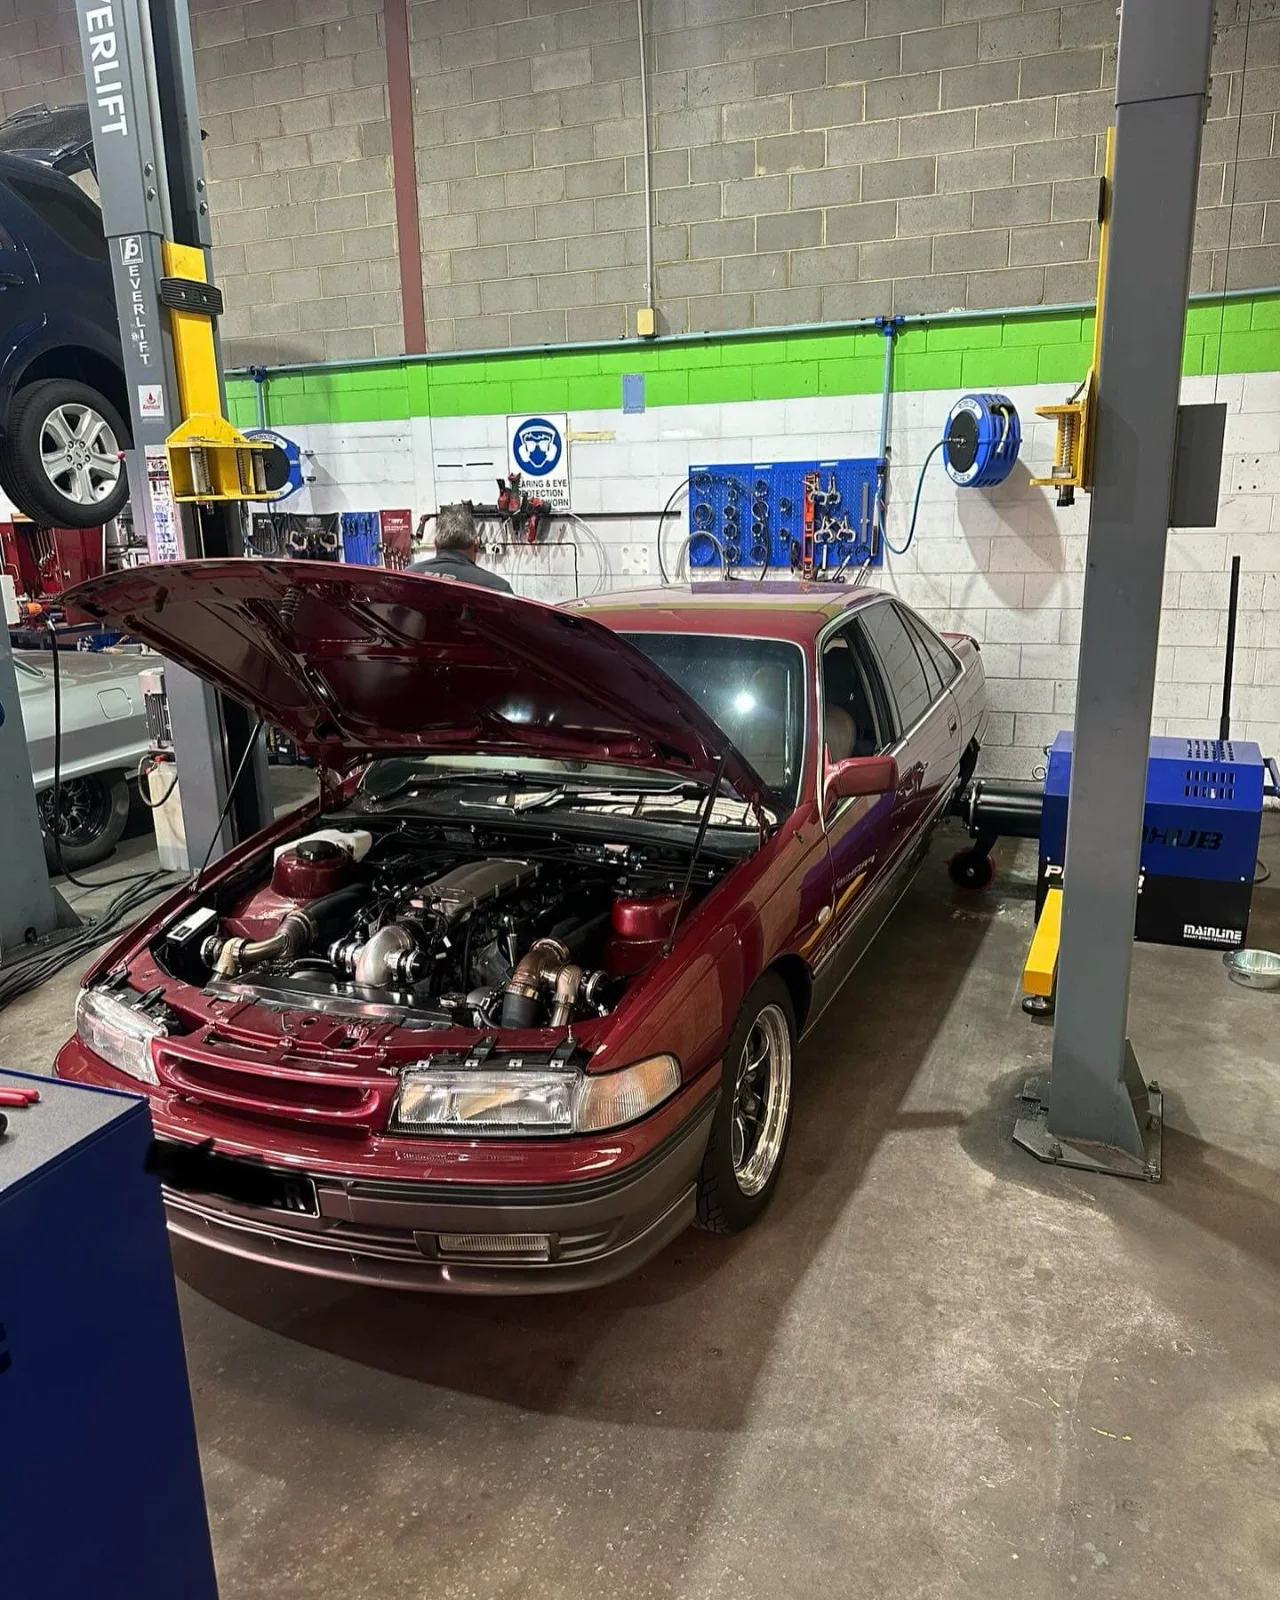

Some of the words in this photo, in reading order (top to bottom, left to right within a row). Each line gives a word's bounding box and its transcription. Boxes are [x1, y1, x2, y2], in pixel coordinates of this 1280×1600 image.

[85, 0, 128, 136] ERLIFT
[128, 264, 150, 365] EVERLIFT
[553, 479, 568, 488] EYE
